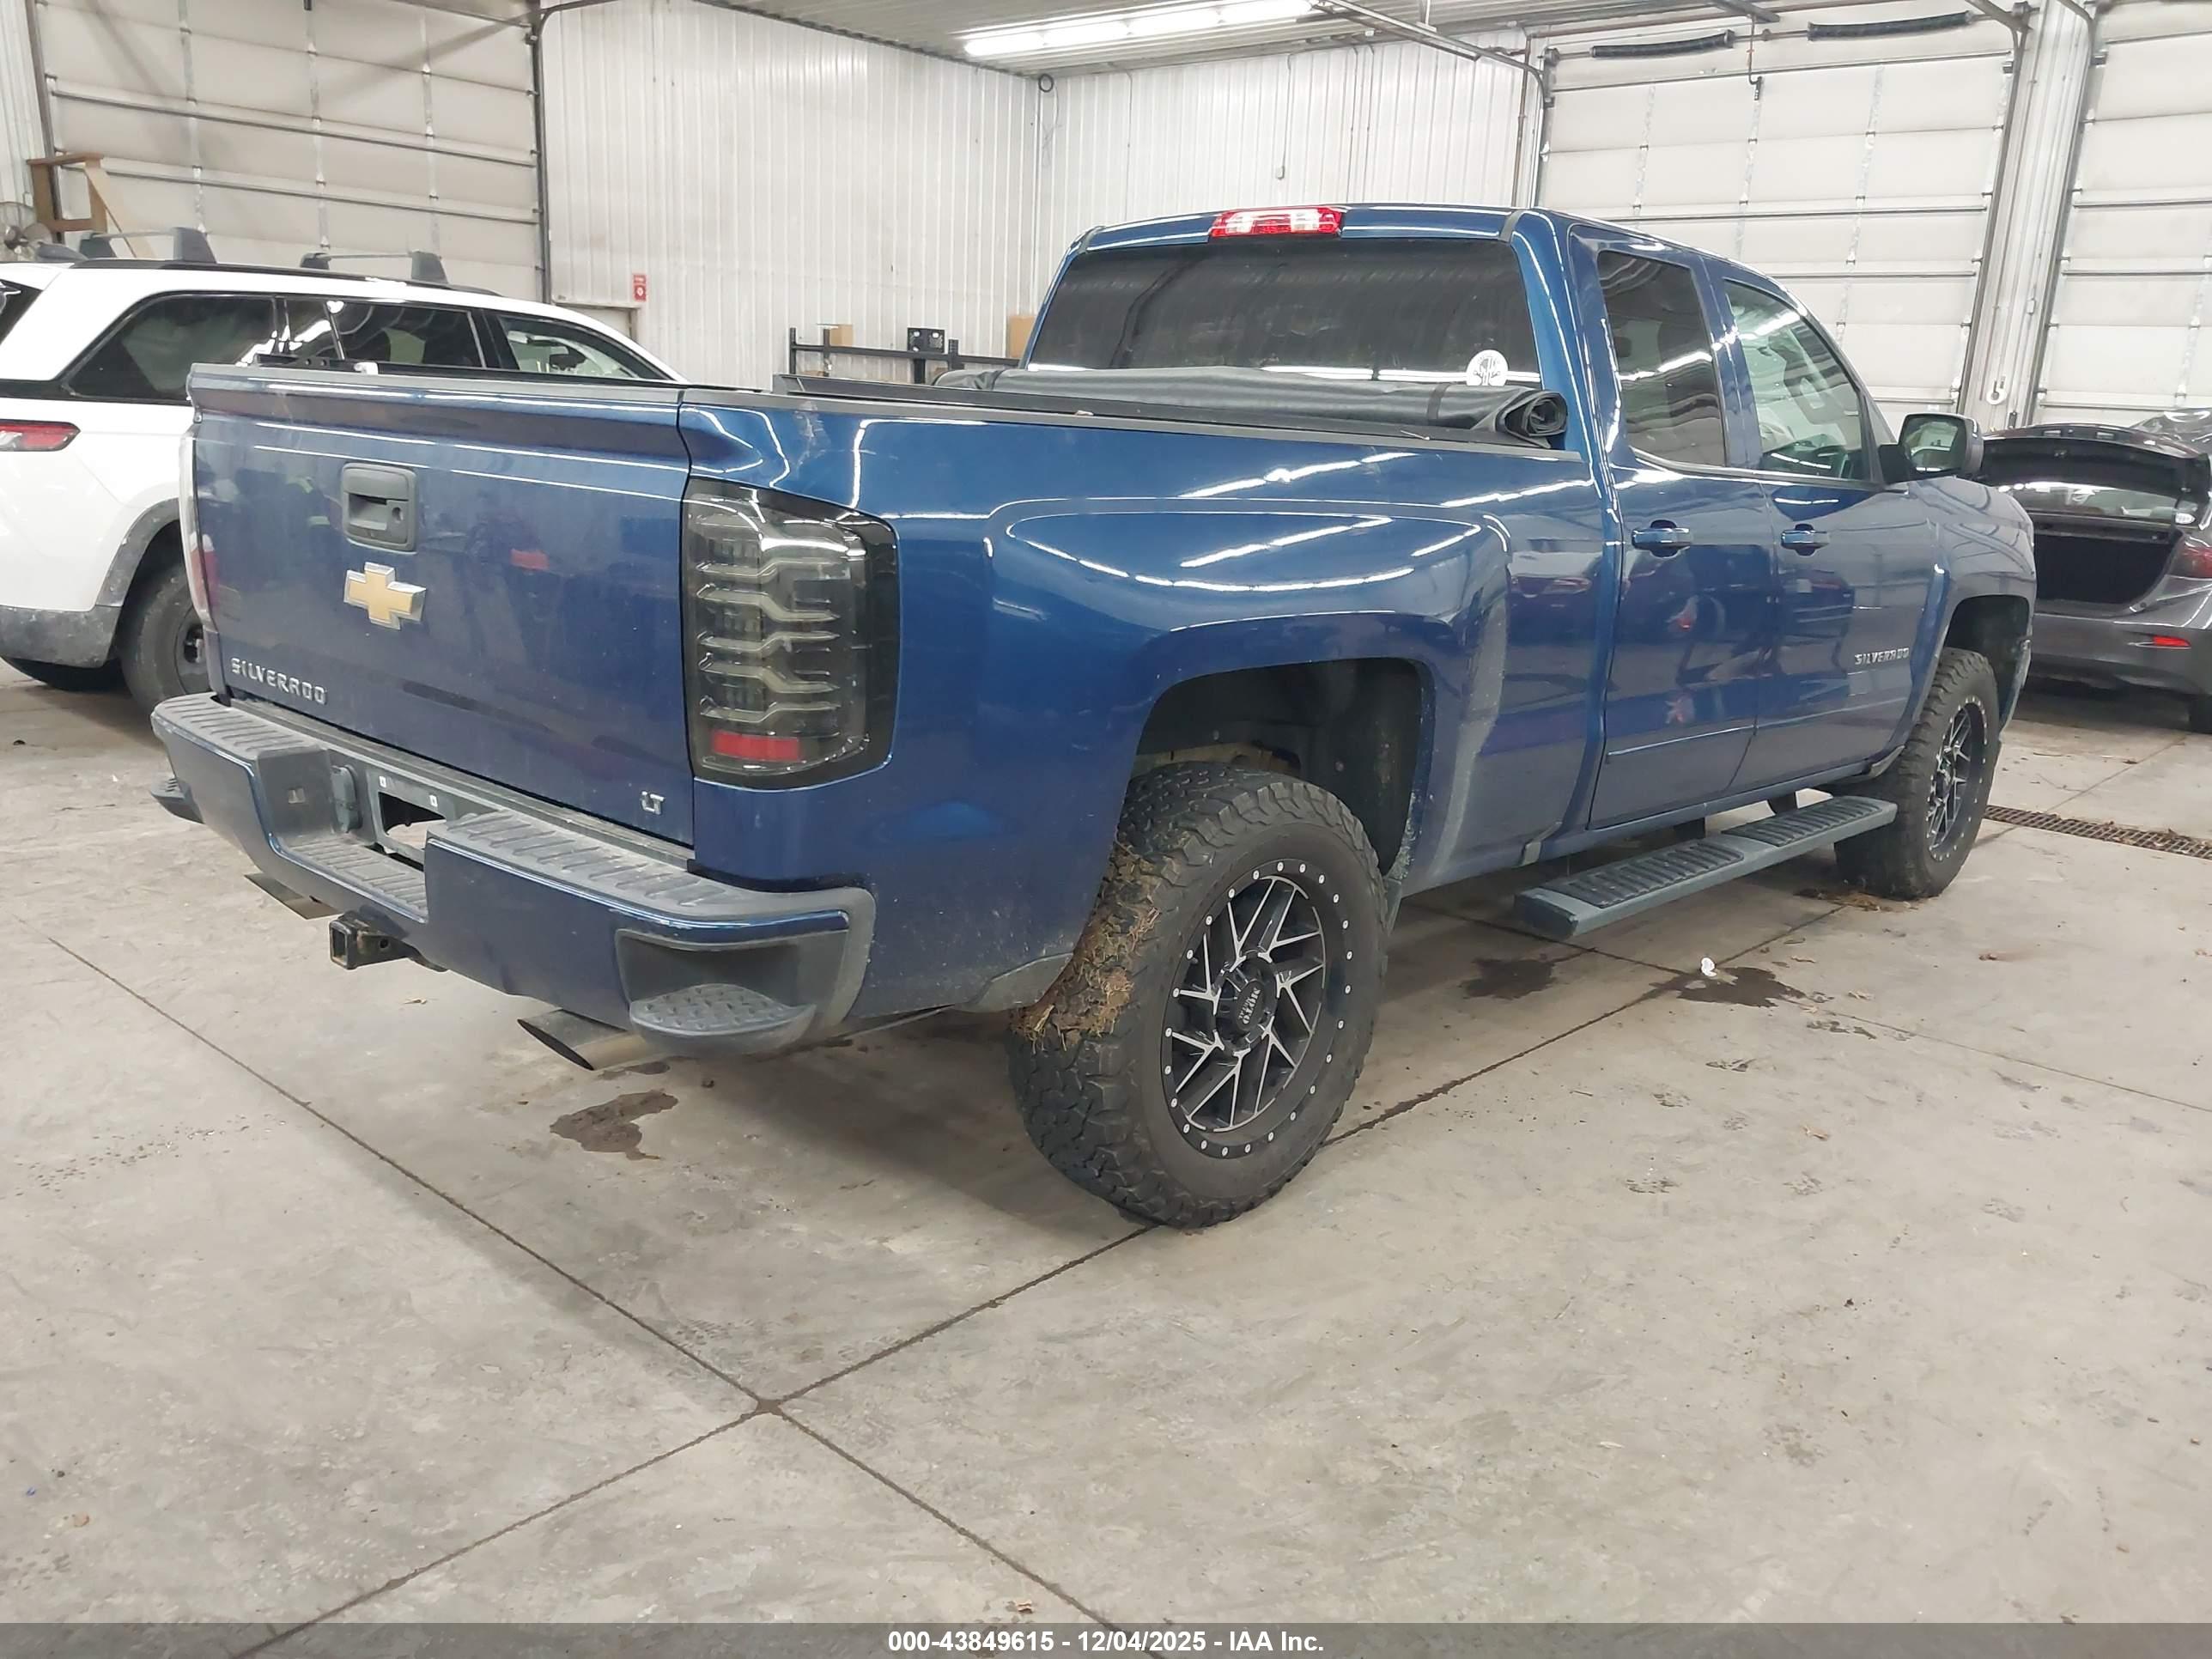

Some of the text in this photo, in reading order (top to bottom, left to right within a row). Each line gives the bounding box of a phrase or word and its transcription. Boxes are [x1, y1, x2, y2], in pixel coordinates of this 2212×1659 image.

[1855, 647, 1909, 665] SILVERADO
[231, 658, 326, 705] SILVERADO
[641, 791, 665, 815] LT
